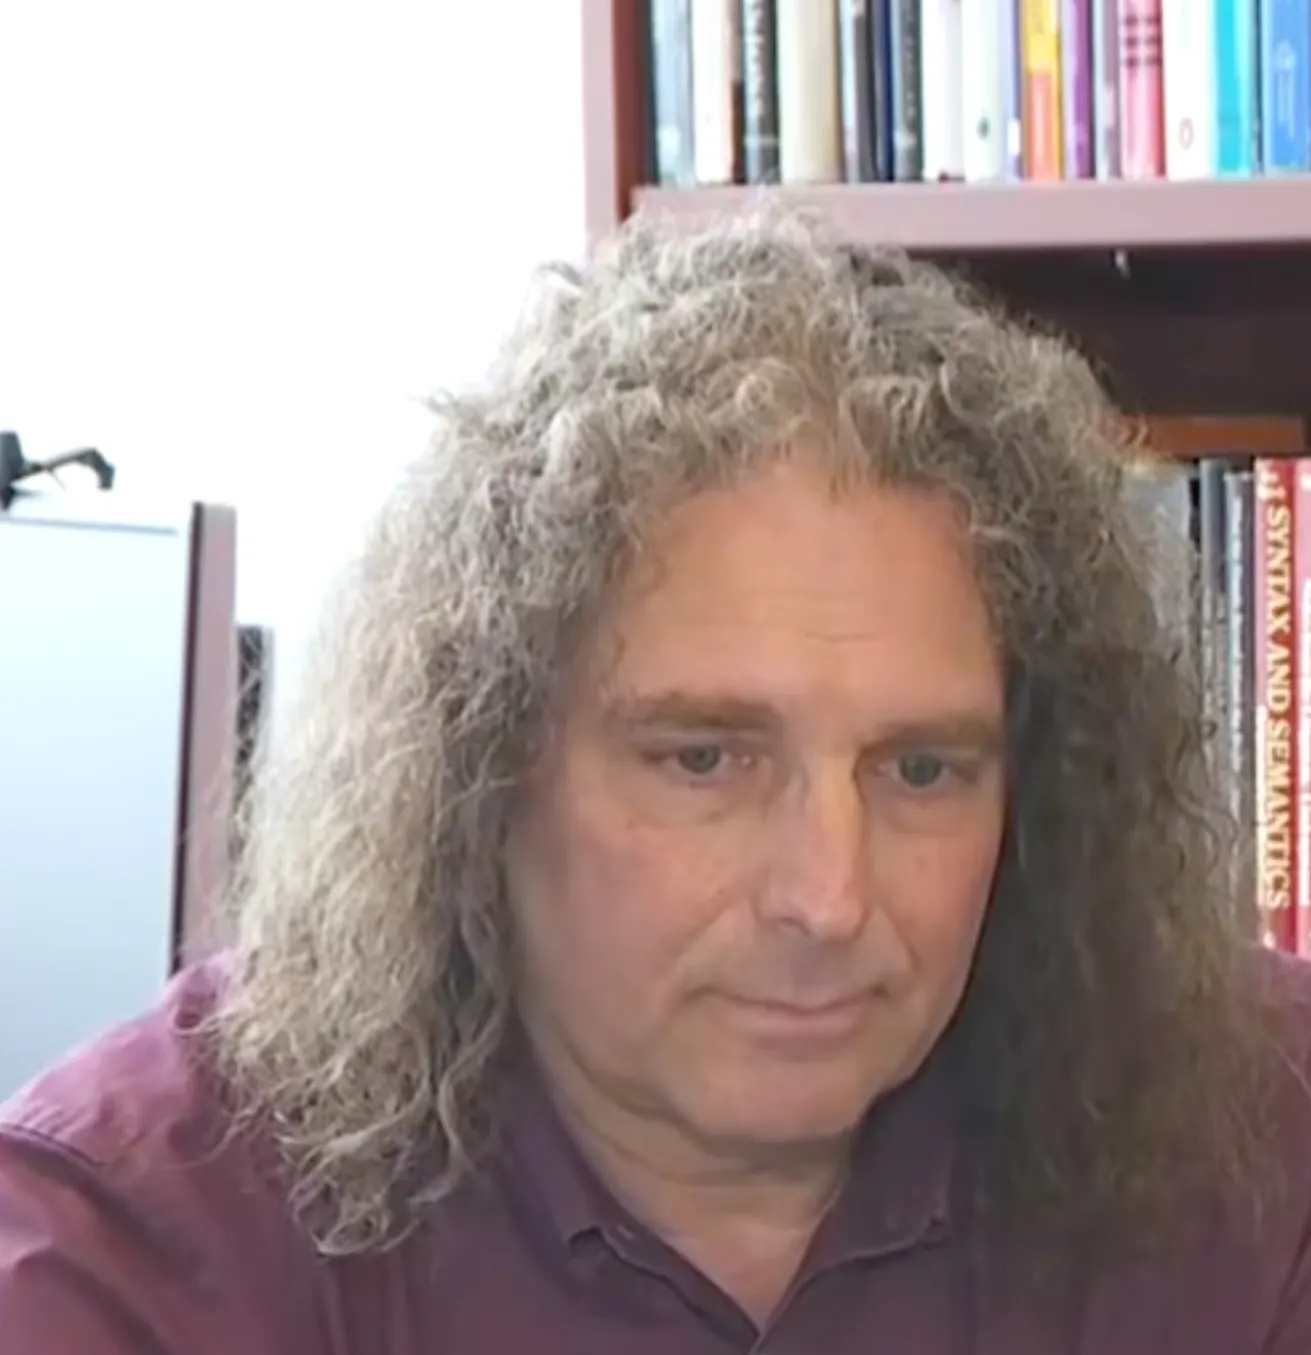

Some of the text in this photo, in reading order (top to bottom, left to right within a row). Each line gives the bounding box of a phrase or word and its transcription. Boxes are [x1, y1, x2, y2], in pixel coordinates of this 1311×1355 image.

[1267, 505, 1291, 632] SYNTAX
[1267, 637, 1291, 712] AND
[1265, 718, 1291, 909] SEMANTICS
